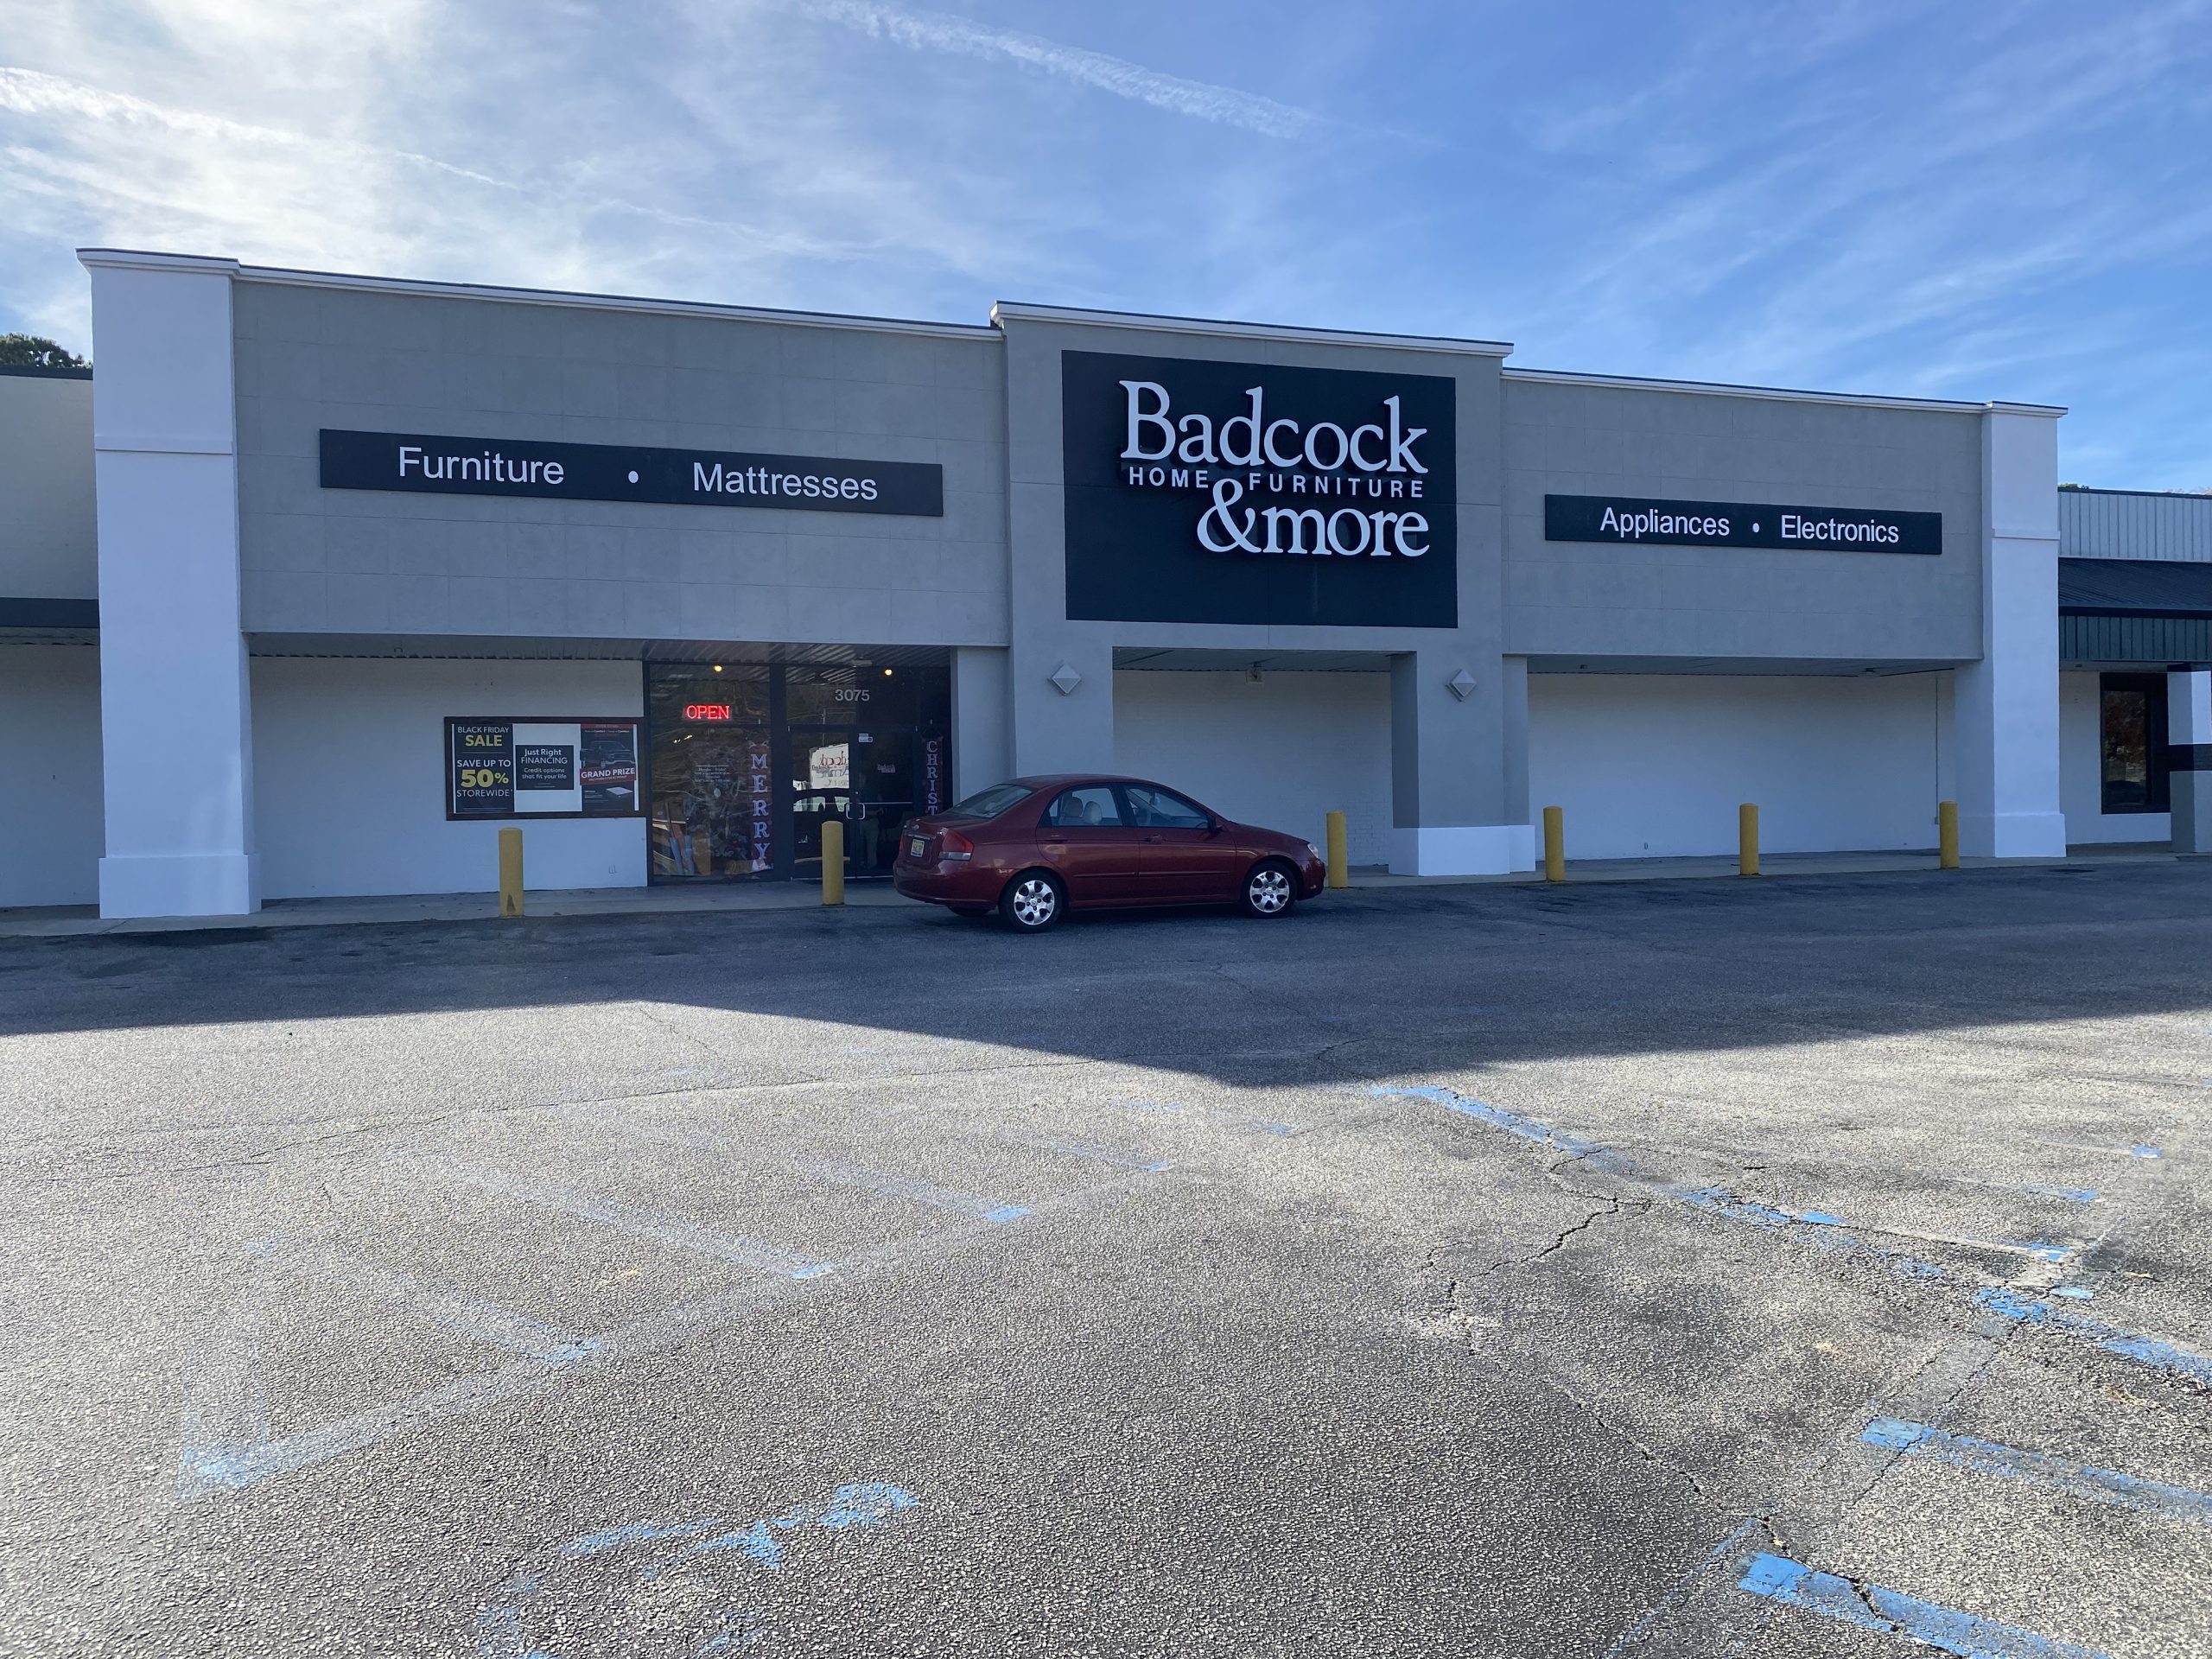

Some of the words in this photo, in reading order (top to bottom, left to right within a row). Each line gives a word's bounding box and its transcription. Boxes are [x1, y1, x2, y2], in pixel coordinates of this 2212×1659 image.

[1119, 379, 1428, 474] Badcock
[398, 446, 564, 485] Furniture
[693, 461, 878, 500] Mattresses
[1129, 467, 1209, 489] HOME
[1249, 473, 1423, 498] FURNITURE
[1197, 478, 1430, 557] &more
[1599, 506, 1730, 538] Appliances
[1781, 514, 1899, 543] Electronics
[835, 689, 870, 702] 3075
[686, 704, 730, 720] OPEN
[465, 734, 503, 747] SALE
[524, 748, 540, 757] Just
[541, 748, 562, 757] Right
[461, 768, 509, 788] 50%
[581, 769, 610, 779] GRAND
[612, 767, 636, 776] PRIZE
[750, 753, 771, 859] MERRY
